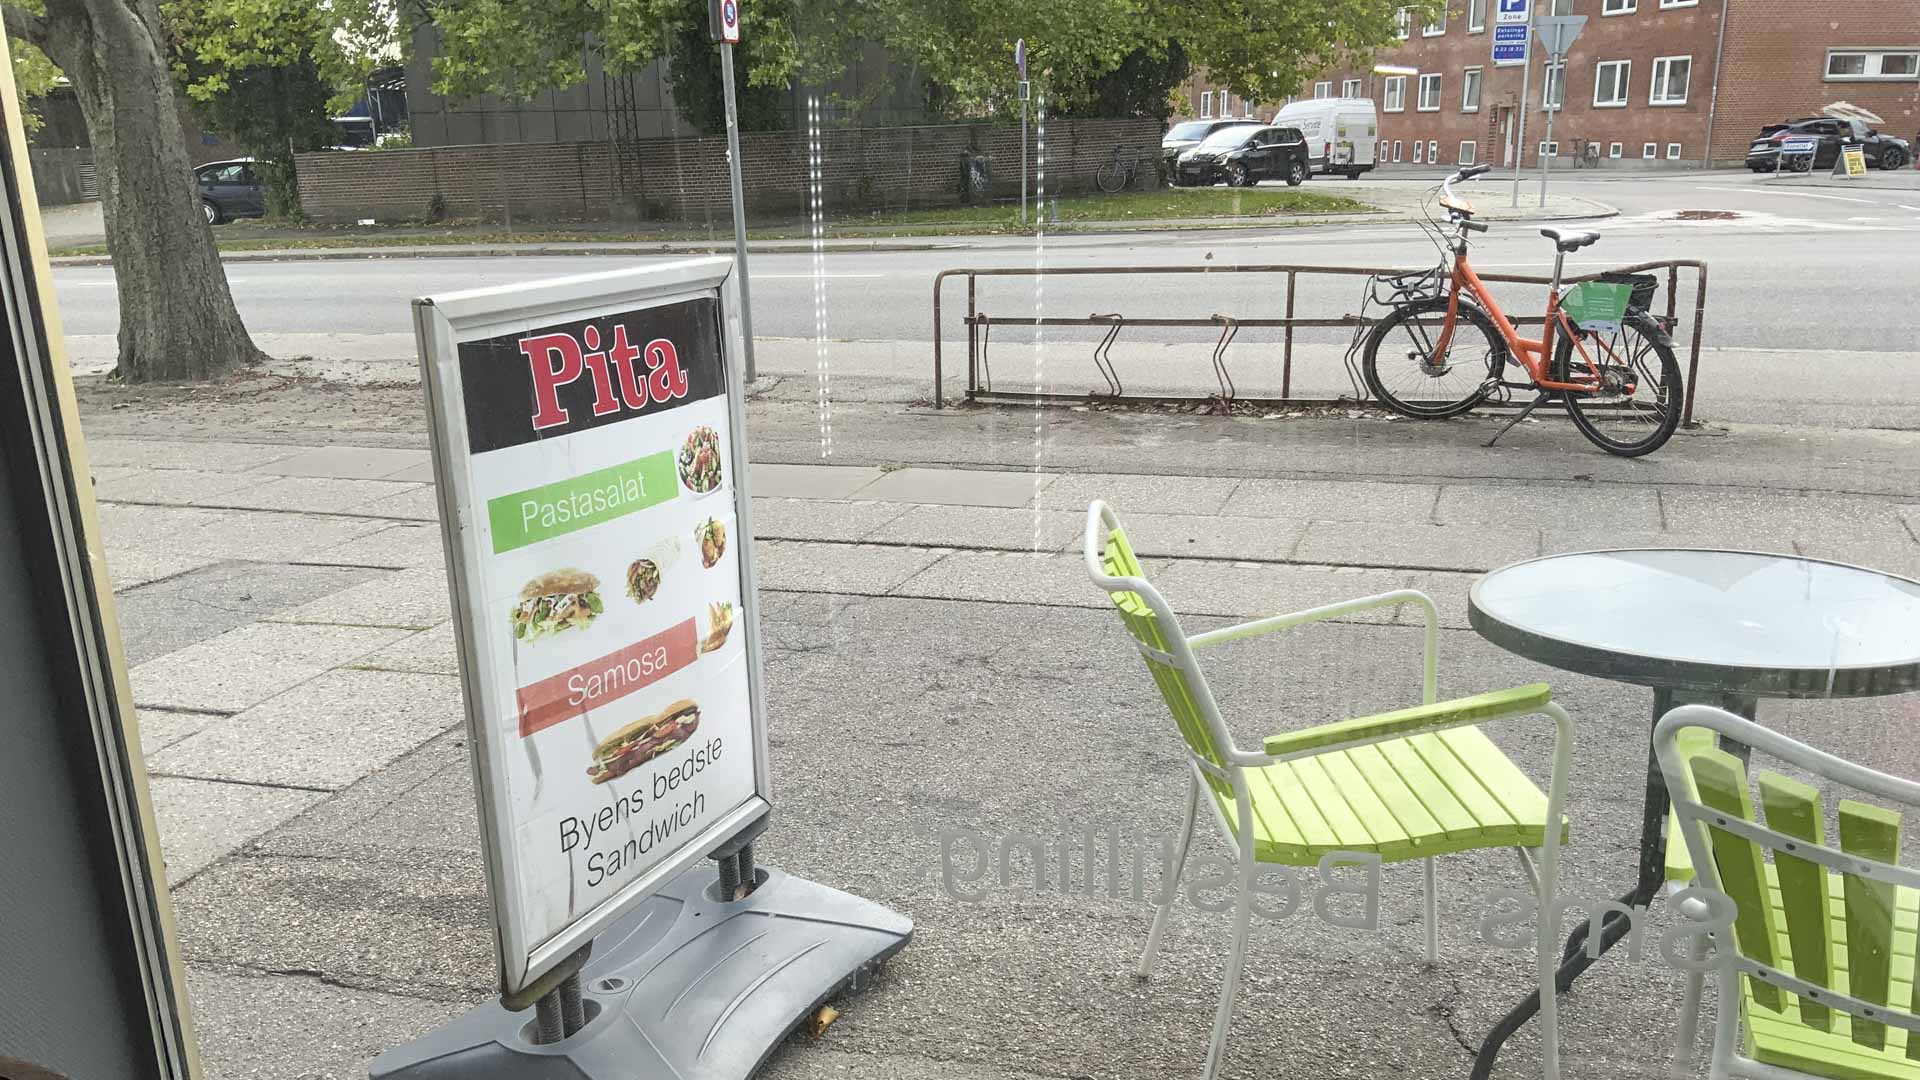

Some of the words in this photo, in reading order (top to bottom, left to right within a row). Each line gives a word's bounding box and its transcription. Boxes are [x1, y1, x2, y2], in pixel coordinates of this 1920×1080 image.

[520, 324, 689, 431] Pita
[520, 471, 647, 534] Pastasalat
[567, 645, 669, 707] Samosa
[558, 788, 644, 853] Byens
[652, 736, 723, 802] bedste
[586, 790, 706, 888] Sandwich
